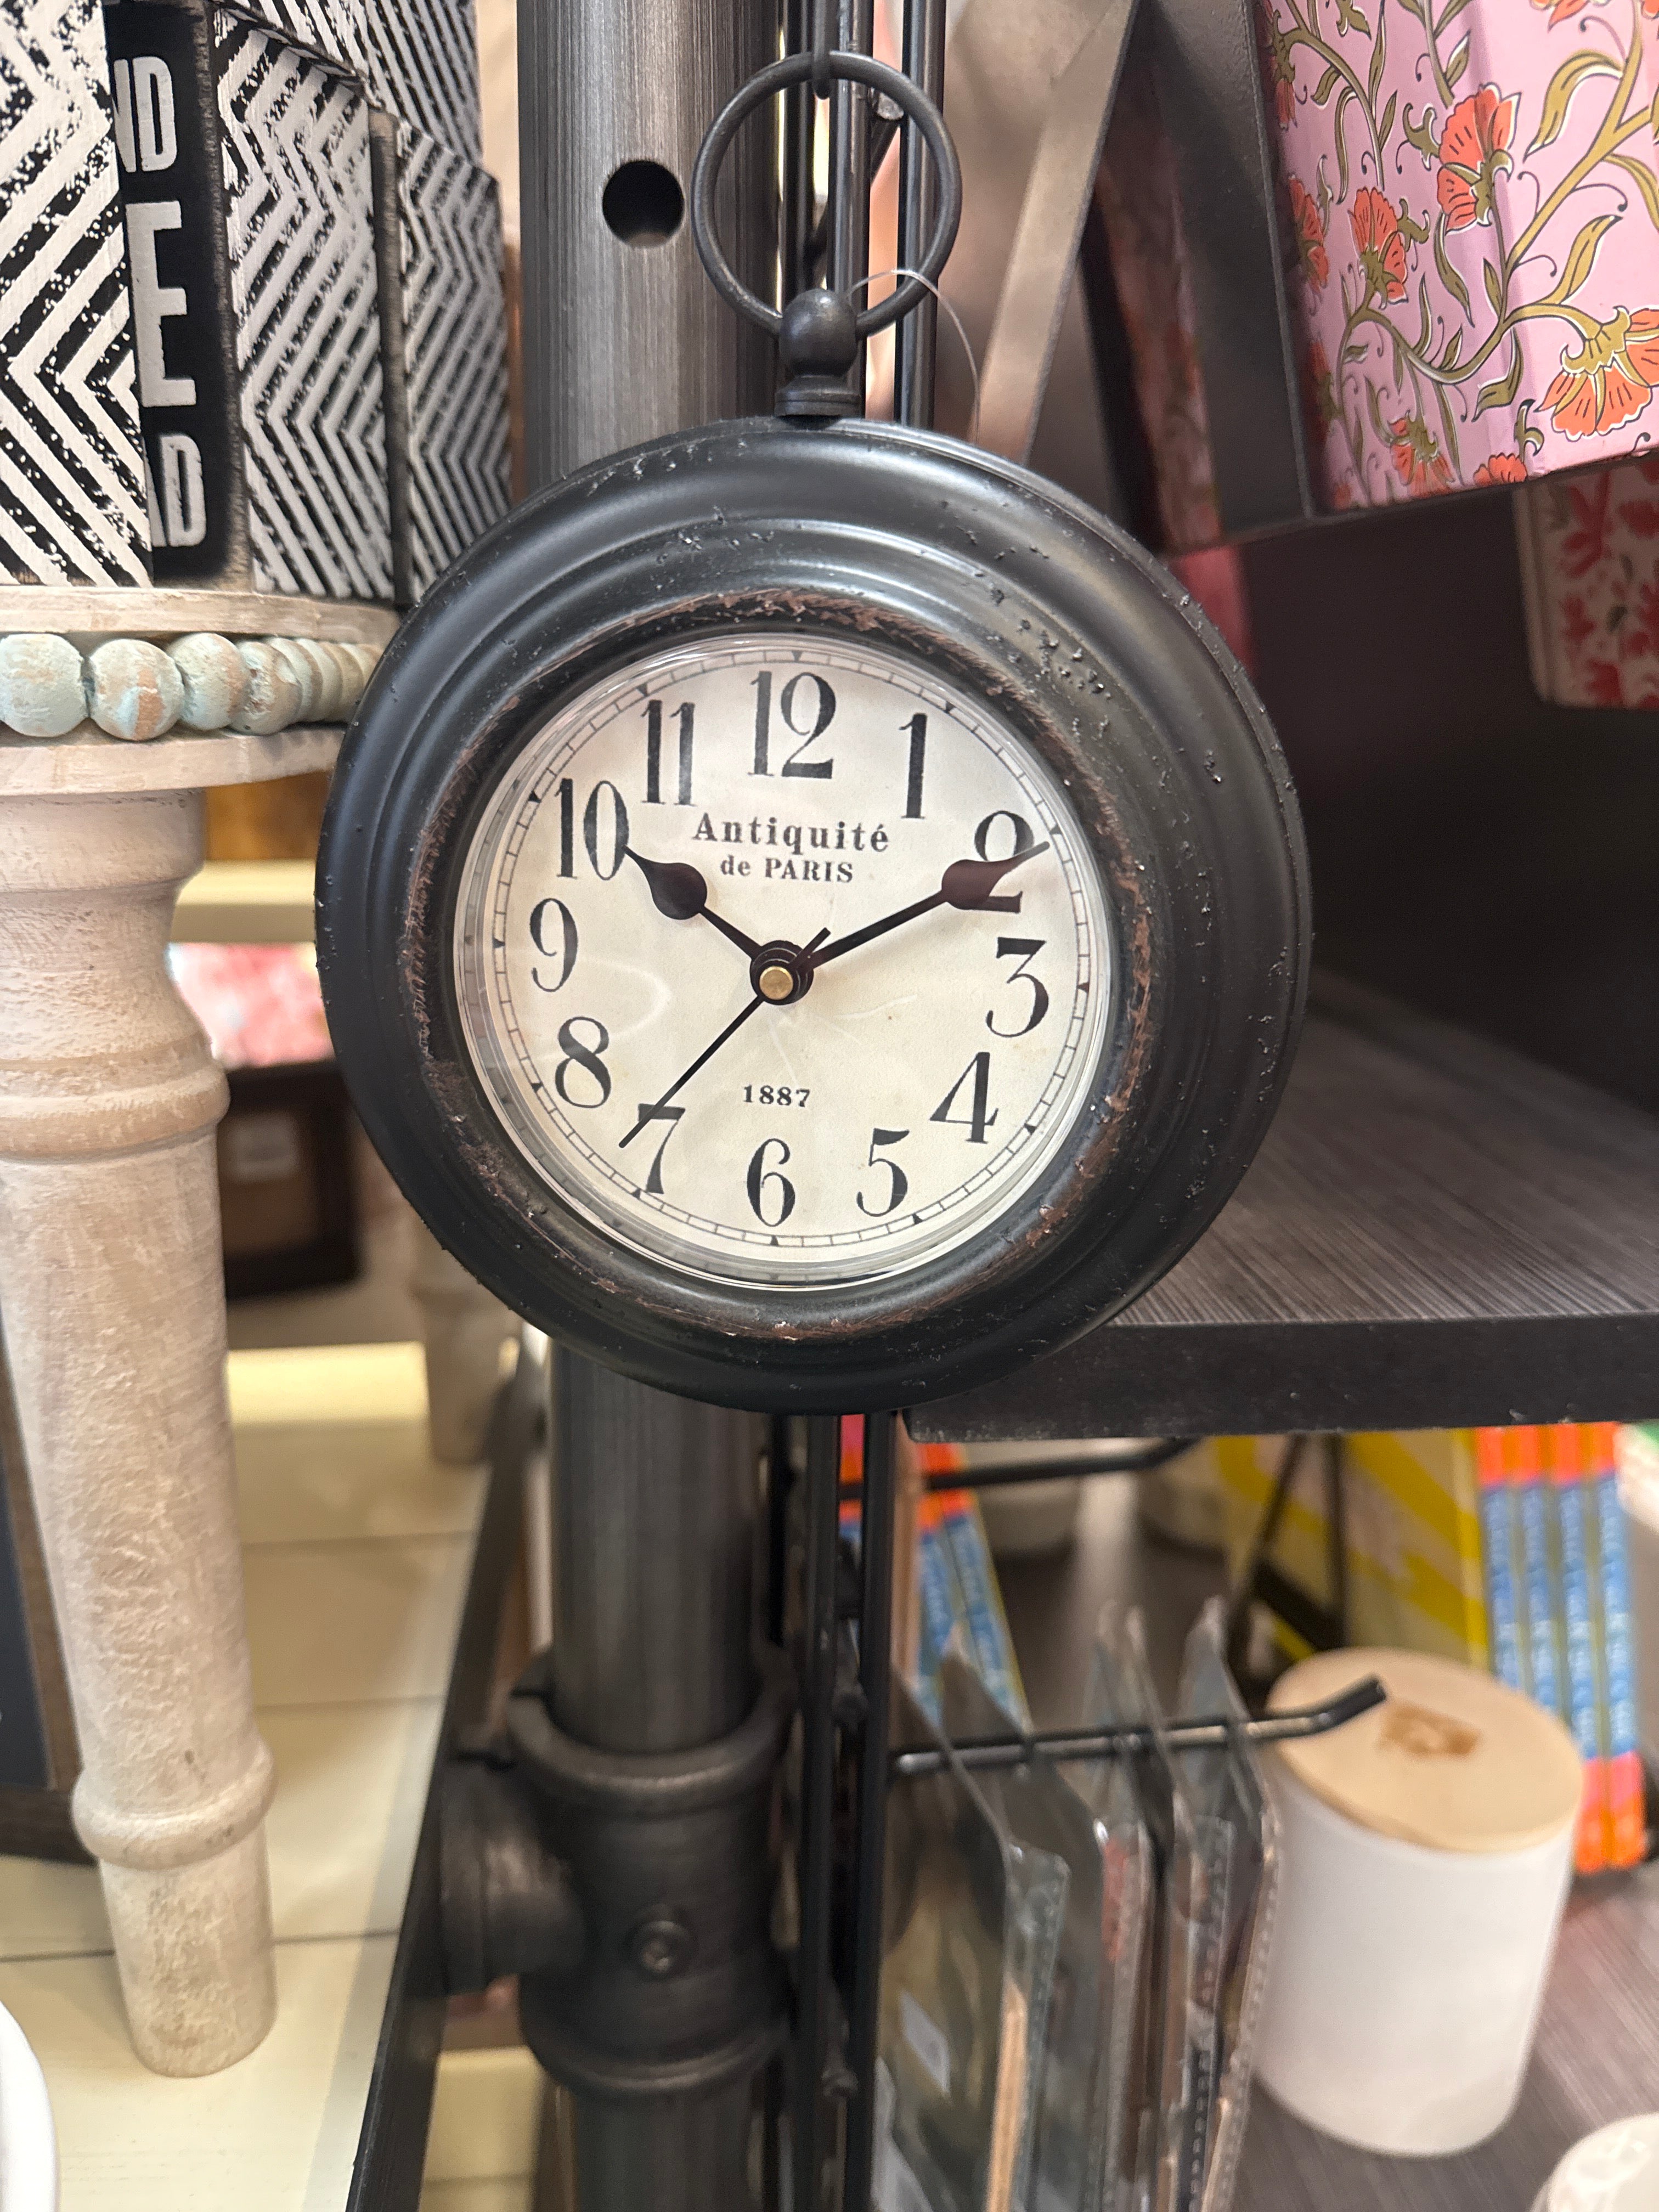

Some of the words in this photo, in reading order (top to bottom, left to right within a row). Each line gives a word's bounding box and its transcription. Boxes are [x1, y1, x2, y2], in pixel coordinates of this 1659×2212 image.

[640, 699, 696, 806] 11
[747, 670, 837, 779] 12
[899, 713, 928, 819] 1
[554, 777, 630, 881] 10
[692, 811, 889, 856] Antiquité
[720, 854, 751, 877] de
[765, 857, 854, 884] PARIS
[973, 810, 1035, 915] 2
[529, 898, 579, 993] 9
[985, 936, 1049, 1039] 3
[555, 1015, 612, 1109] 8
[743, 1084, 811, 1108] 1887
[929, 1051, 999, 1144] 4
[637, 1102, 686, 1195] 7
[746, 1137, 796, 1228] 6
[856, 1127, 910, 1217] 5
